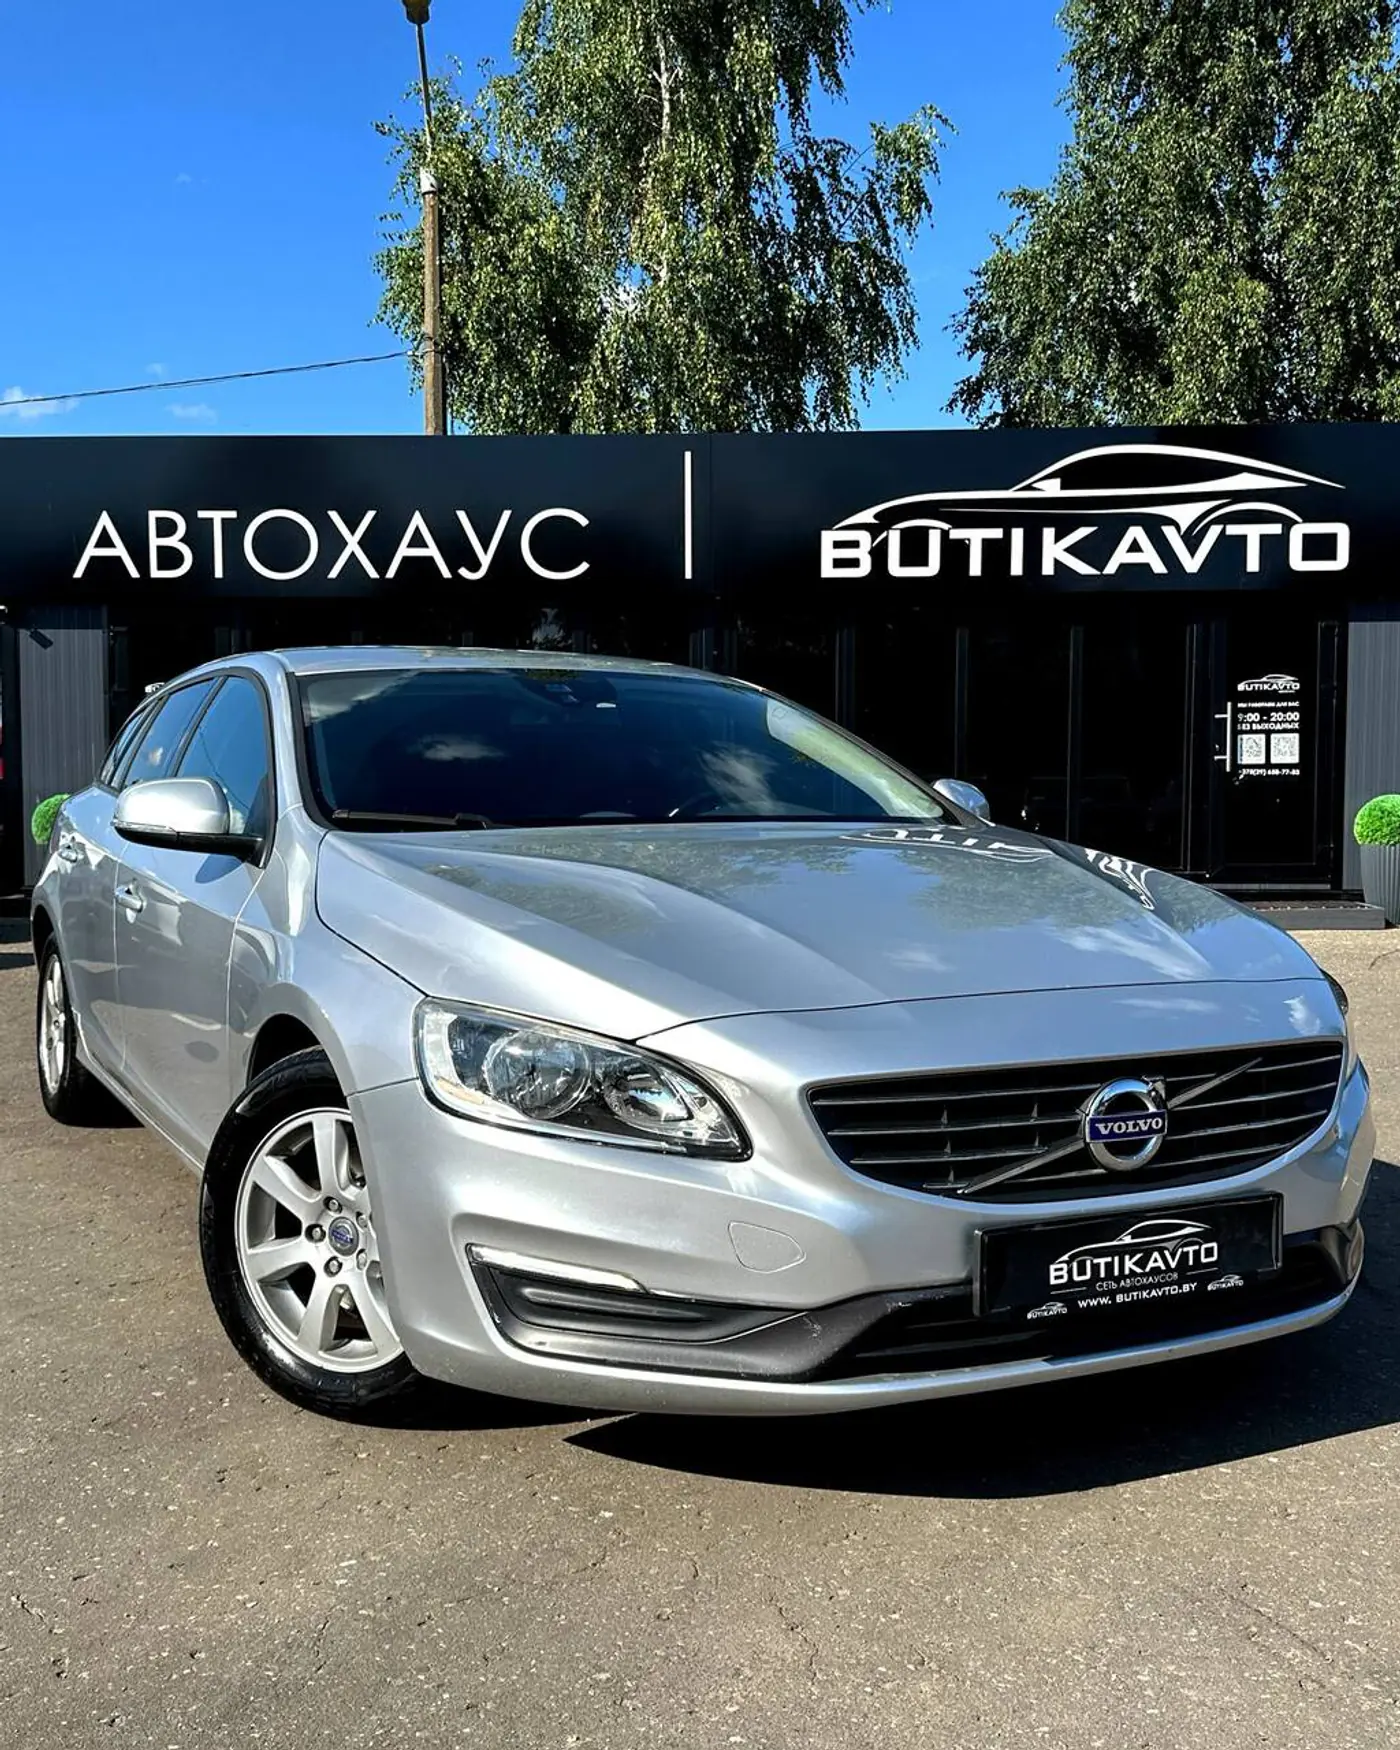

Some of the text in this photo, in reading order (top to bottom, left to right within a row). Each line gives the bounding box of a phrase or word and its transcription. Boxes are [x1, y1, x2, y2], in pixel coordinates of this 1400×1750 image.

[73, 508, 590, 580] АВТОХАУС
[820, 521, 1350, 579] BUTIKAVTO
[1237, 712, 1260, 722] 9:00
[1270, 711, 1300, 722] 20:00
[1252, 722, 1300, 731] ВЫХОДНЫХ
[1095, 1117, 1163, 1135] VOLVO
[1049, 1241, 1219, 1286] BUTIKAVTO
[1095, 1272, 1179, 1292] СЕТЬ АВТОХАУСОВ
[1115, 1282, 1198, 1304] BUTIKAVTO.BY
[1026, 1307, 1068, 1320] BUTIKAVTO
